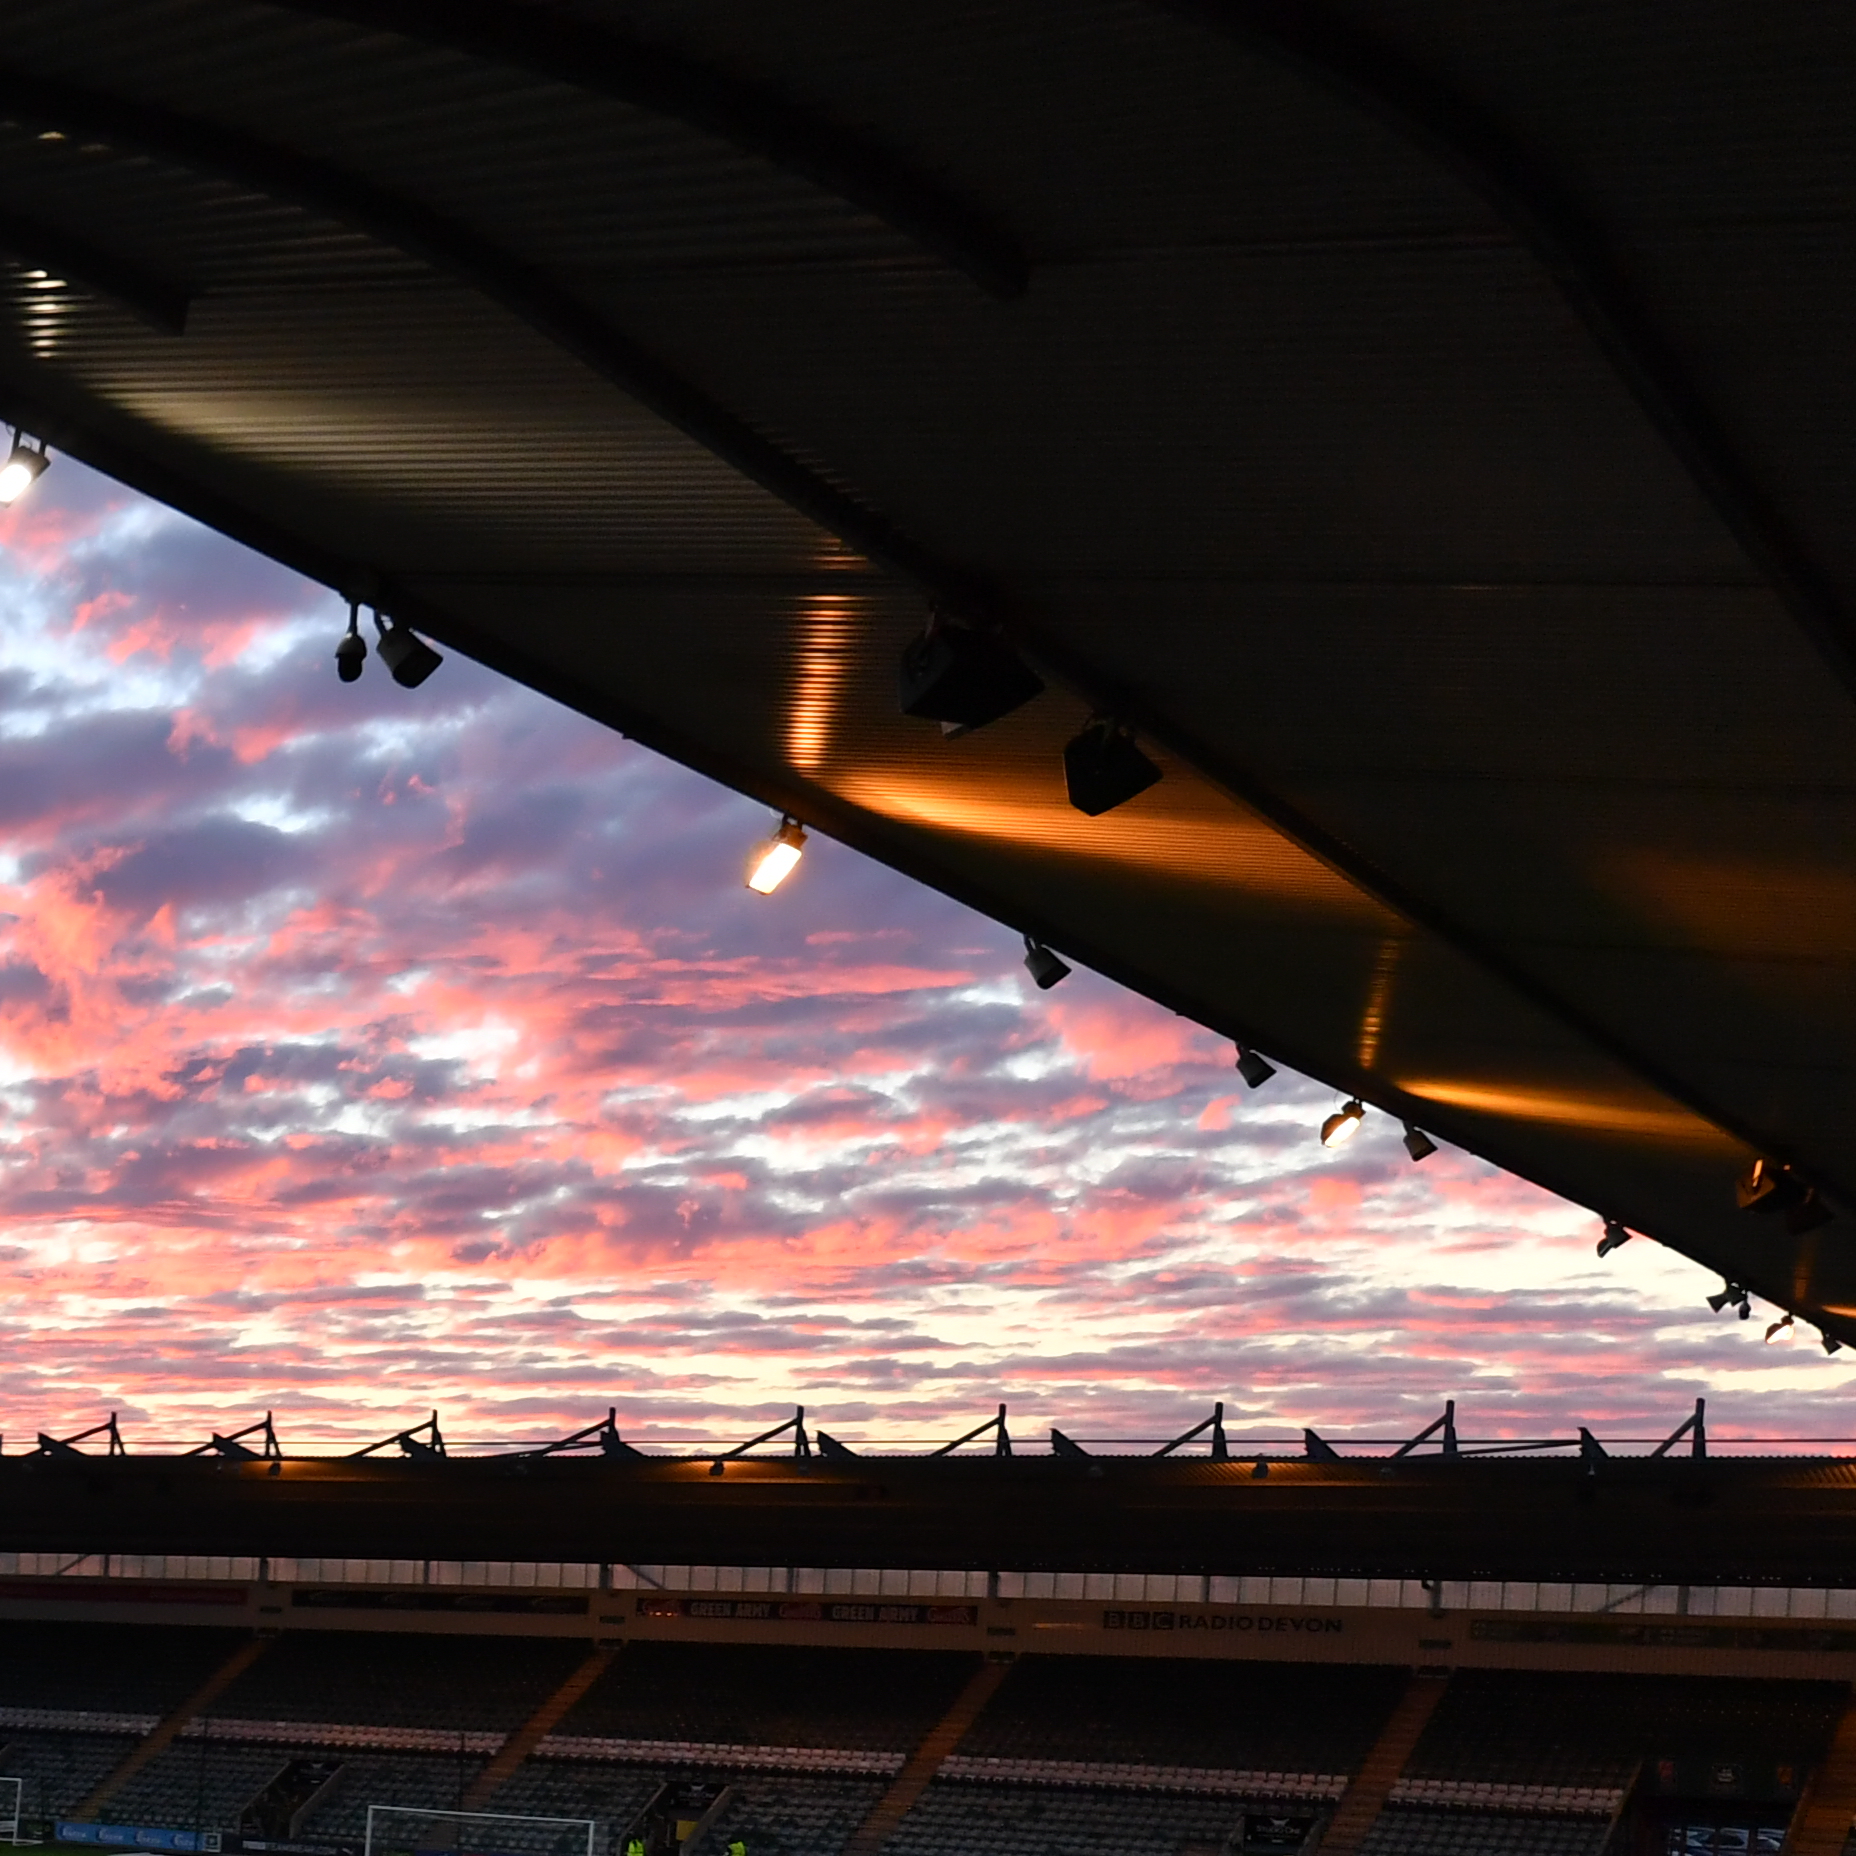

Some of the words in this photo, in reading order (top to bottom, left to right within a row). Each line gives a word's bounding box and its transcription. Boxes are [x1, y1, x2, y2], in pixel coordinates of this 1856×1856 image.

[689, 1601, 731, 1616] GREEN
[735, 1604, 771, 1618] ARMY
[831, 1605, 875, 1620] GREEN
[880, 1607, 920, 1622] ARMY
[1103, 1610, 1174, 1630] BBC
[1180, 1615, 1254, 1631] RADIO
[1257, 1616, 1343, 1633] DEVON
